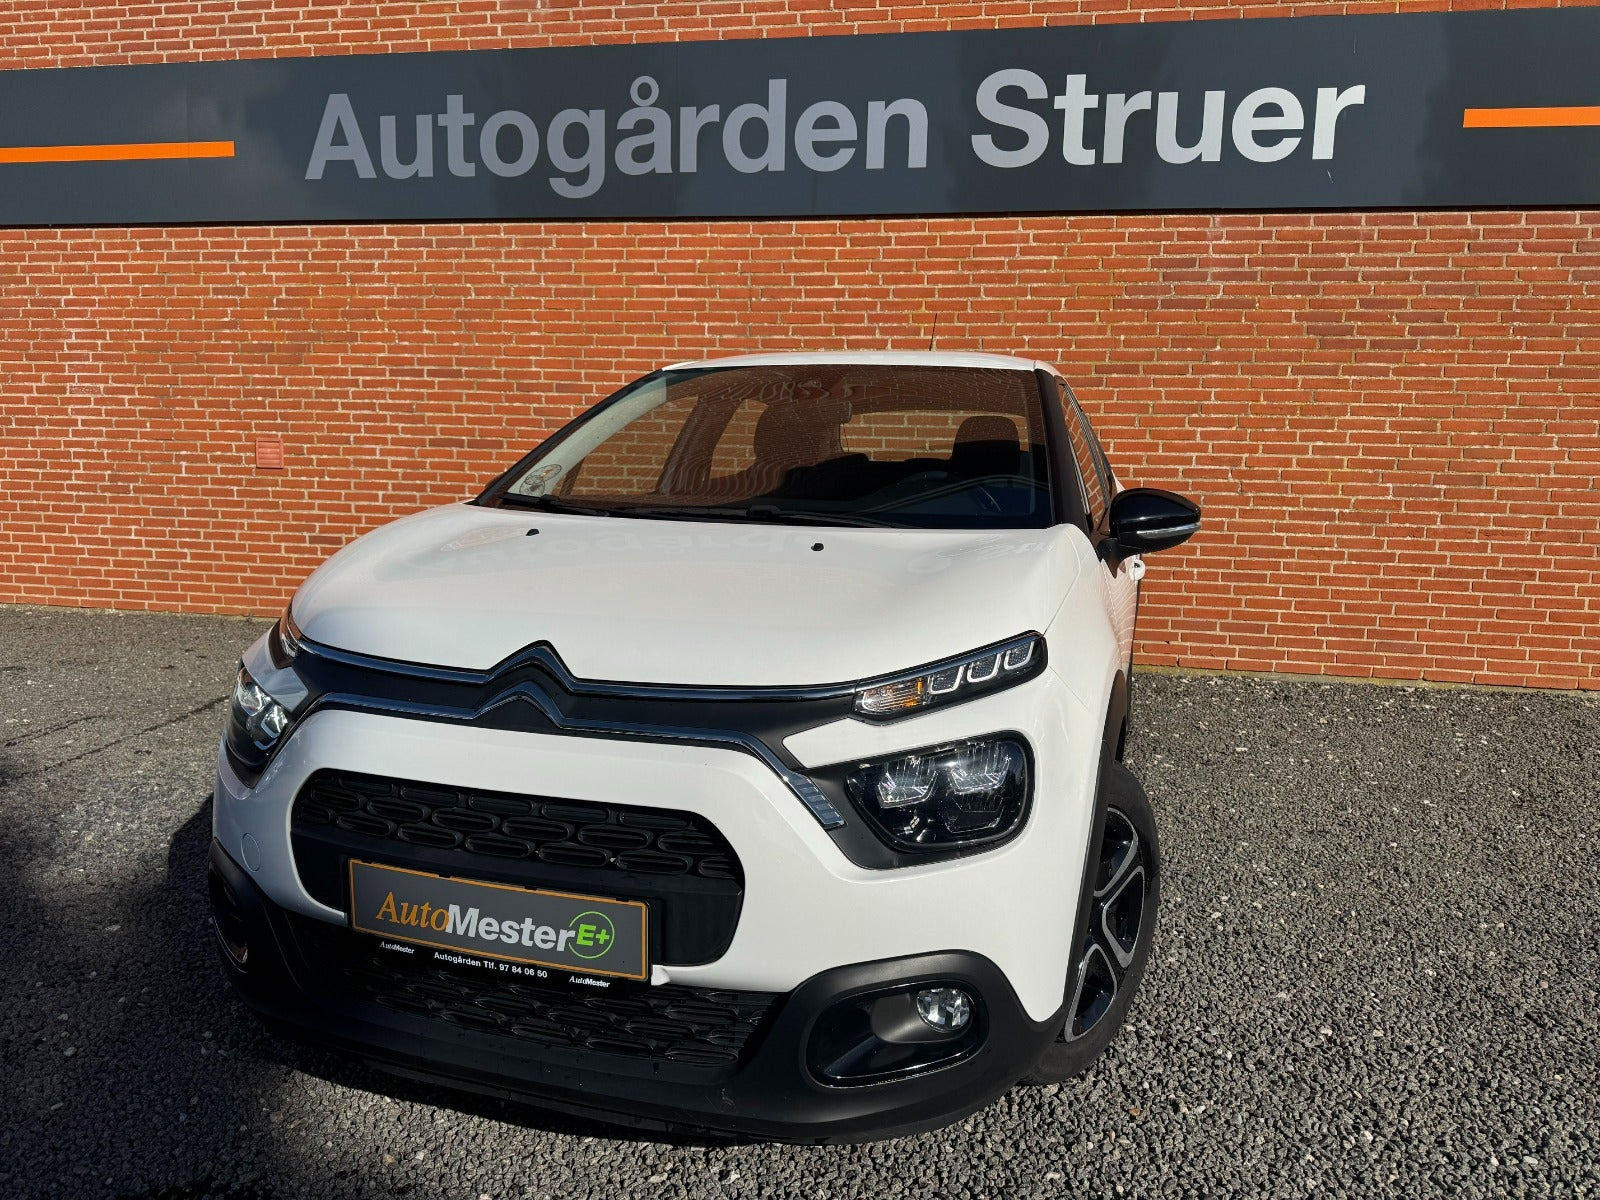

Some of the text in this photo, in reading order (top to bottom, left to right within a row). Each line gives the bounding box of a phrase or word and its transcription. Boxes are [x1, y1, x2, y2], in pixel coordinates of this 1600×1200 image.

[305, 68, 1366, 199] Autogården Struer
[375, 891, 611, 952] AutoMester E+
[434, 951, 548, 978] Autogården Tlf. 97 84 06 50
[569, 975, 611, 988] AutoMester
